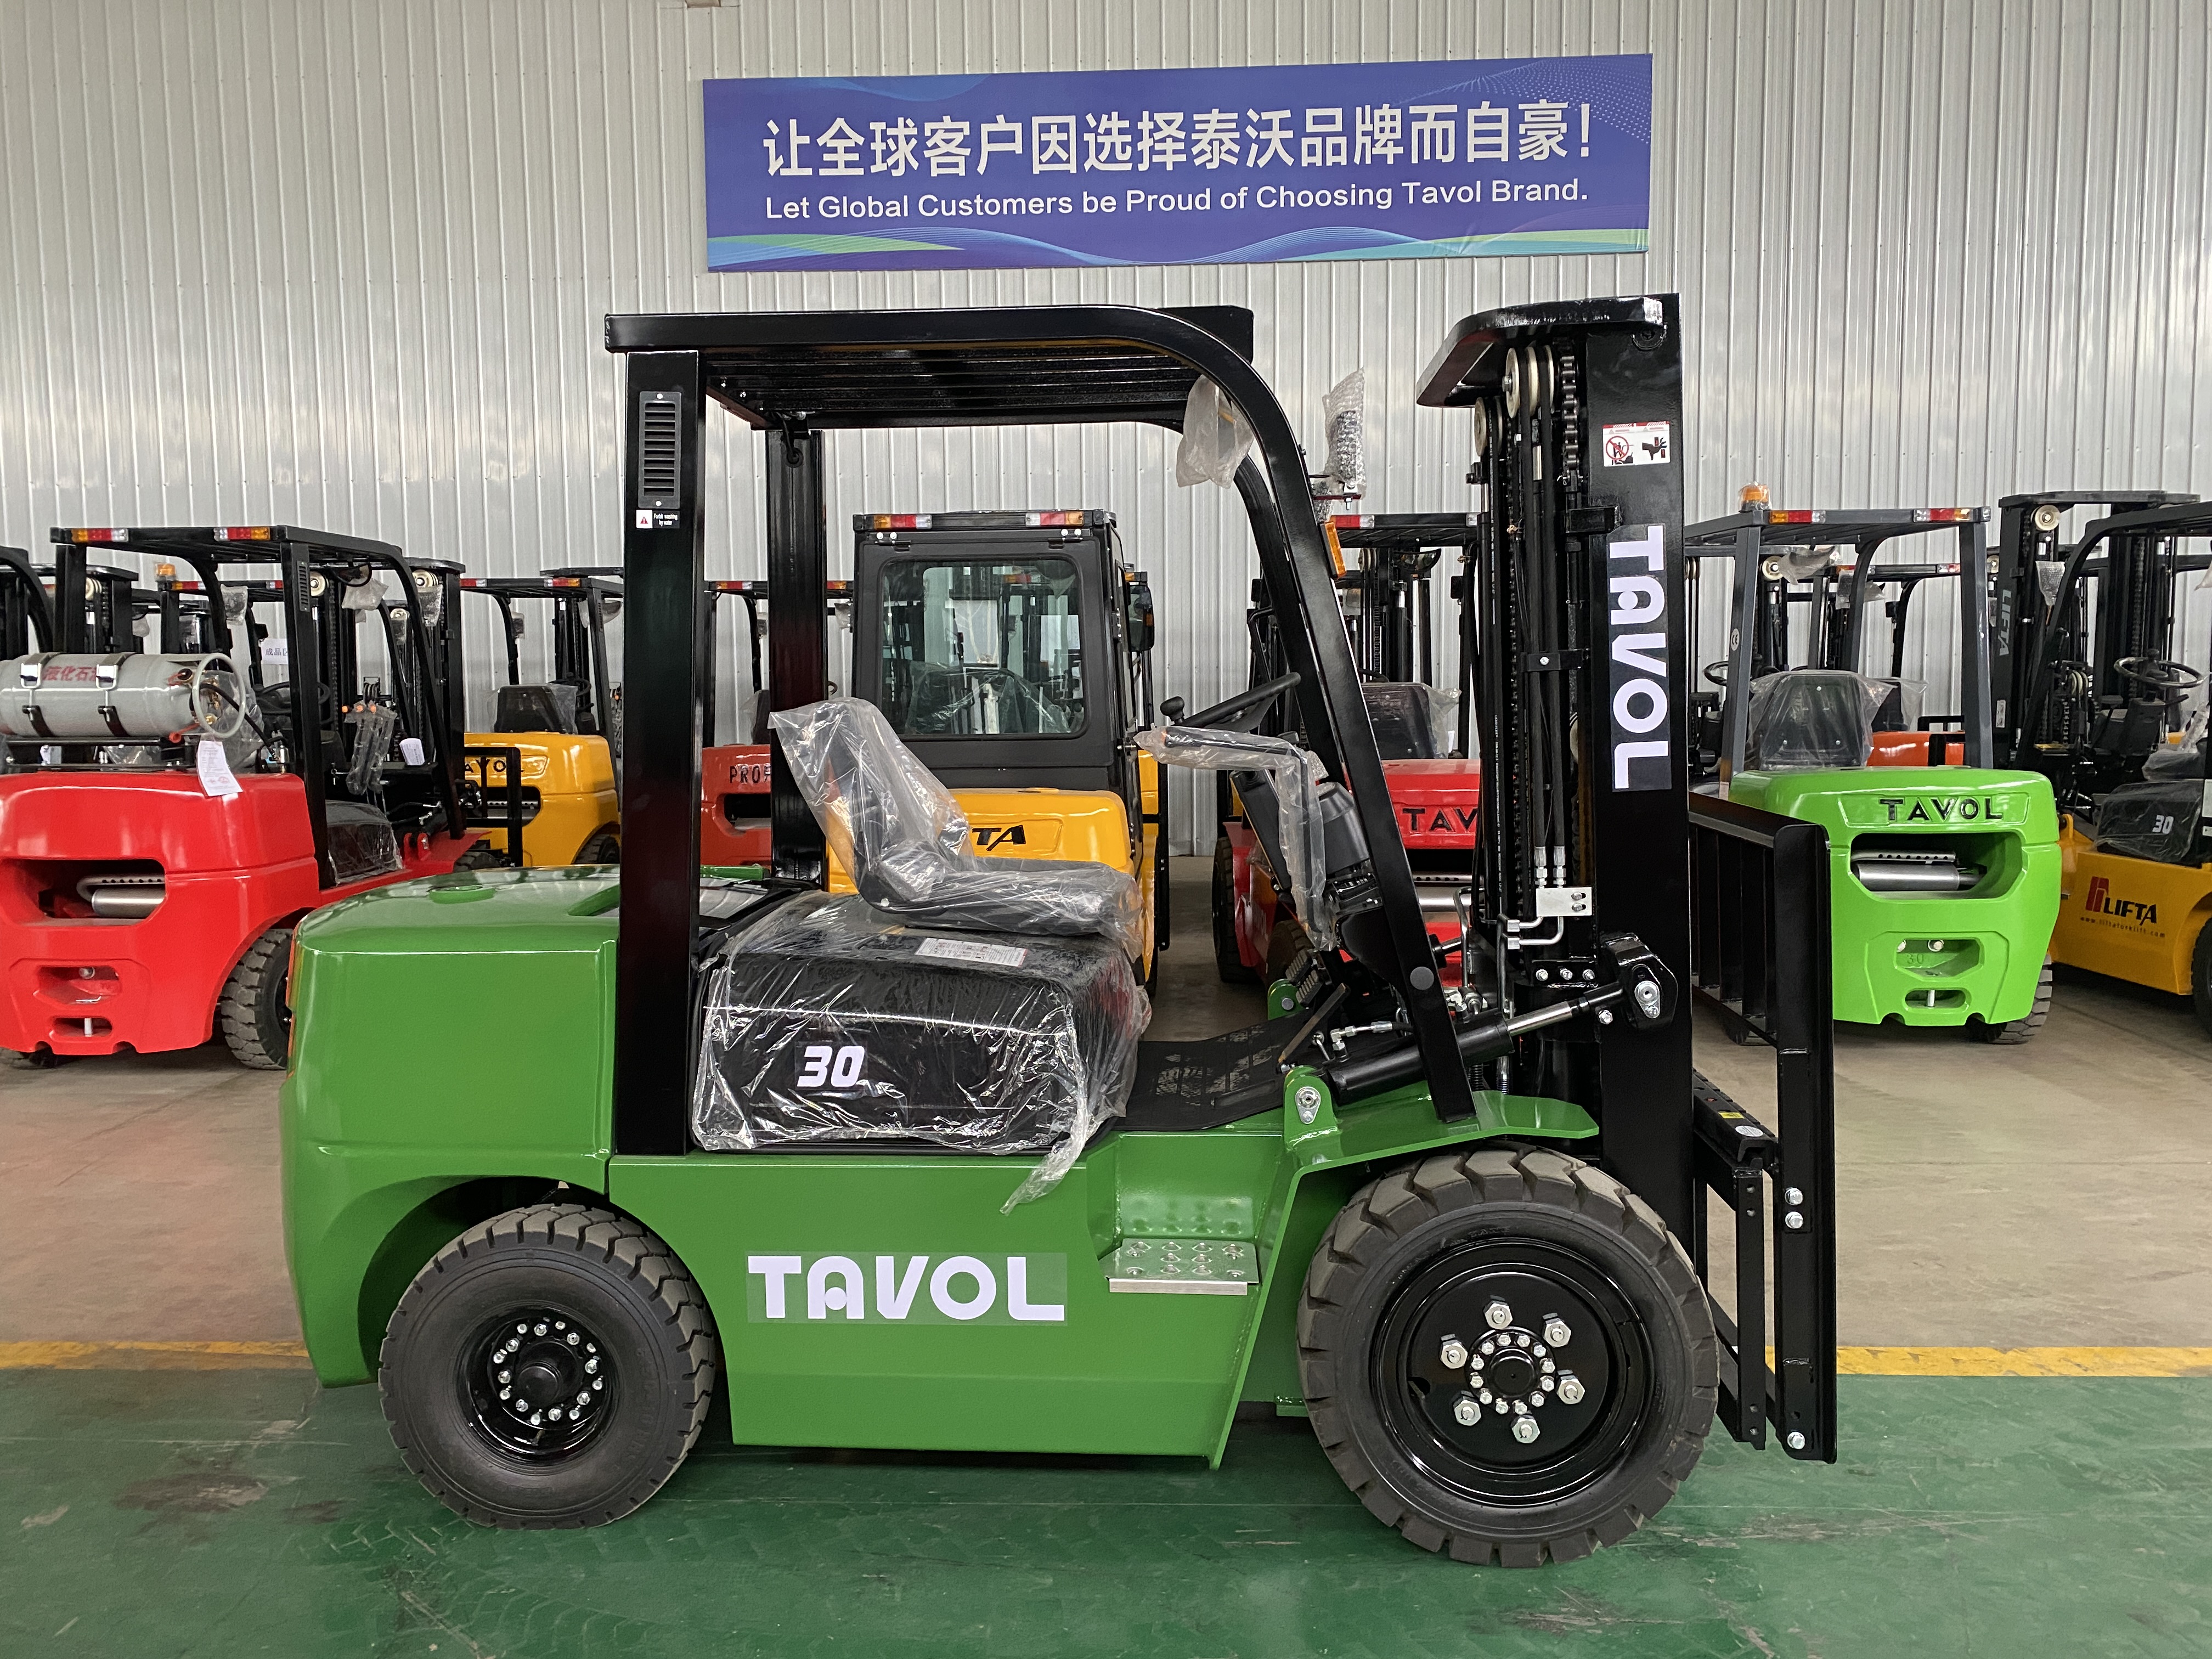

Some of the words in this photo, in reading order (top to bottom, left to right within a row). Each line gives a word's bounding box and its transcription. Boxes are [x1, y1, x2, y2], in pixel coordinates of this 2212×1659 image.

[763, 99, 1590, 177] 让全球客户因选择泰沃品牌而自豪！
[766, 196, 810, 218] Let
[818, 195, 909, 218] Global
[918, 194, 1073, 217] Customers
[1082, 191, 1117, 213] be
[1126, 188, 1211, 212] Proud
[1220, 187, 1249, 210] of
[1256, 183, 1392, 210] Choosing
[1401, 180, 1481, 204] Tavol
[1492, 178, 1588, 202] Brand.
[1997, 589, 2012, 656] LIFTA
[42, 665, 97, 682] 液化石
[1609, 525, 1669, 789] TAVOL
[1879, 797, 2004, 821] TAVOL
[2152, 815, 2174, 834] 30
[2103, 897, 2157, 926] LIFTA
[1906, 953, 1925, 964] 30
[797, 1046, 865, 1087] 30
[747, 1255, 1065, 1321] TAVOL
